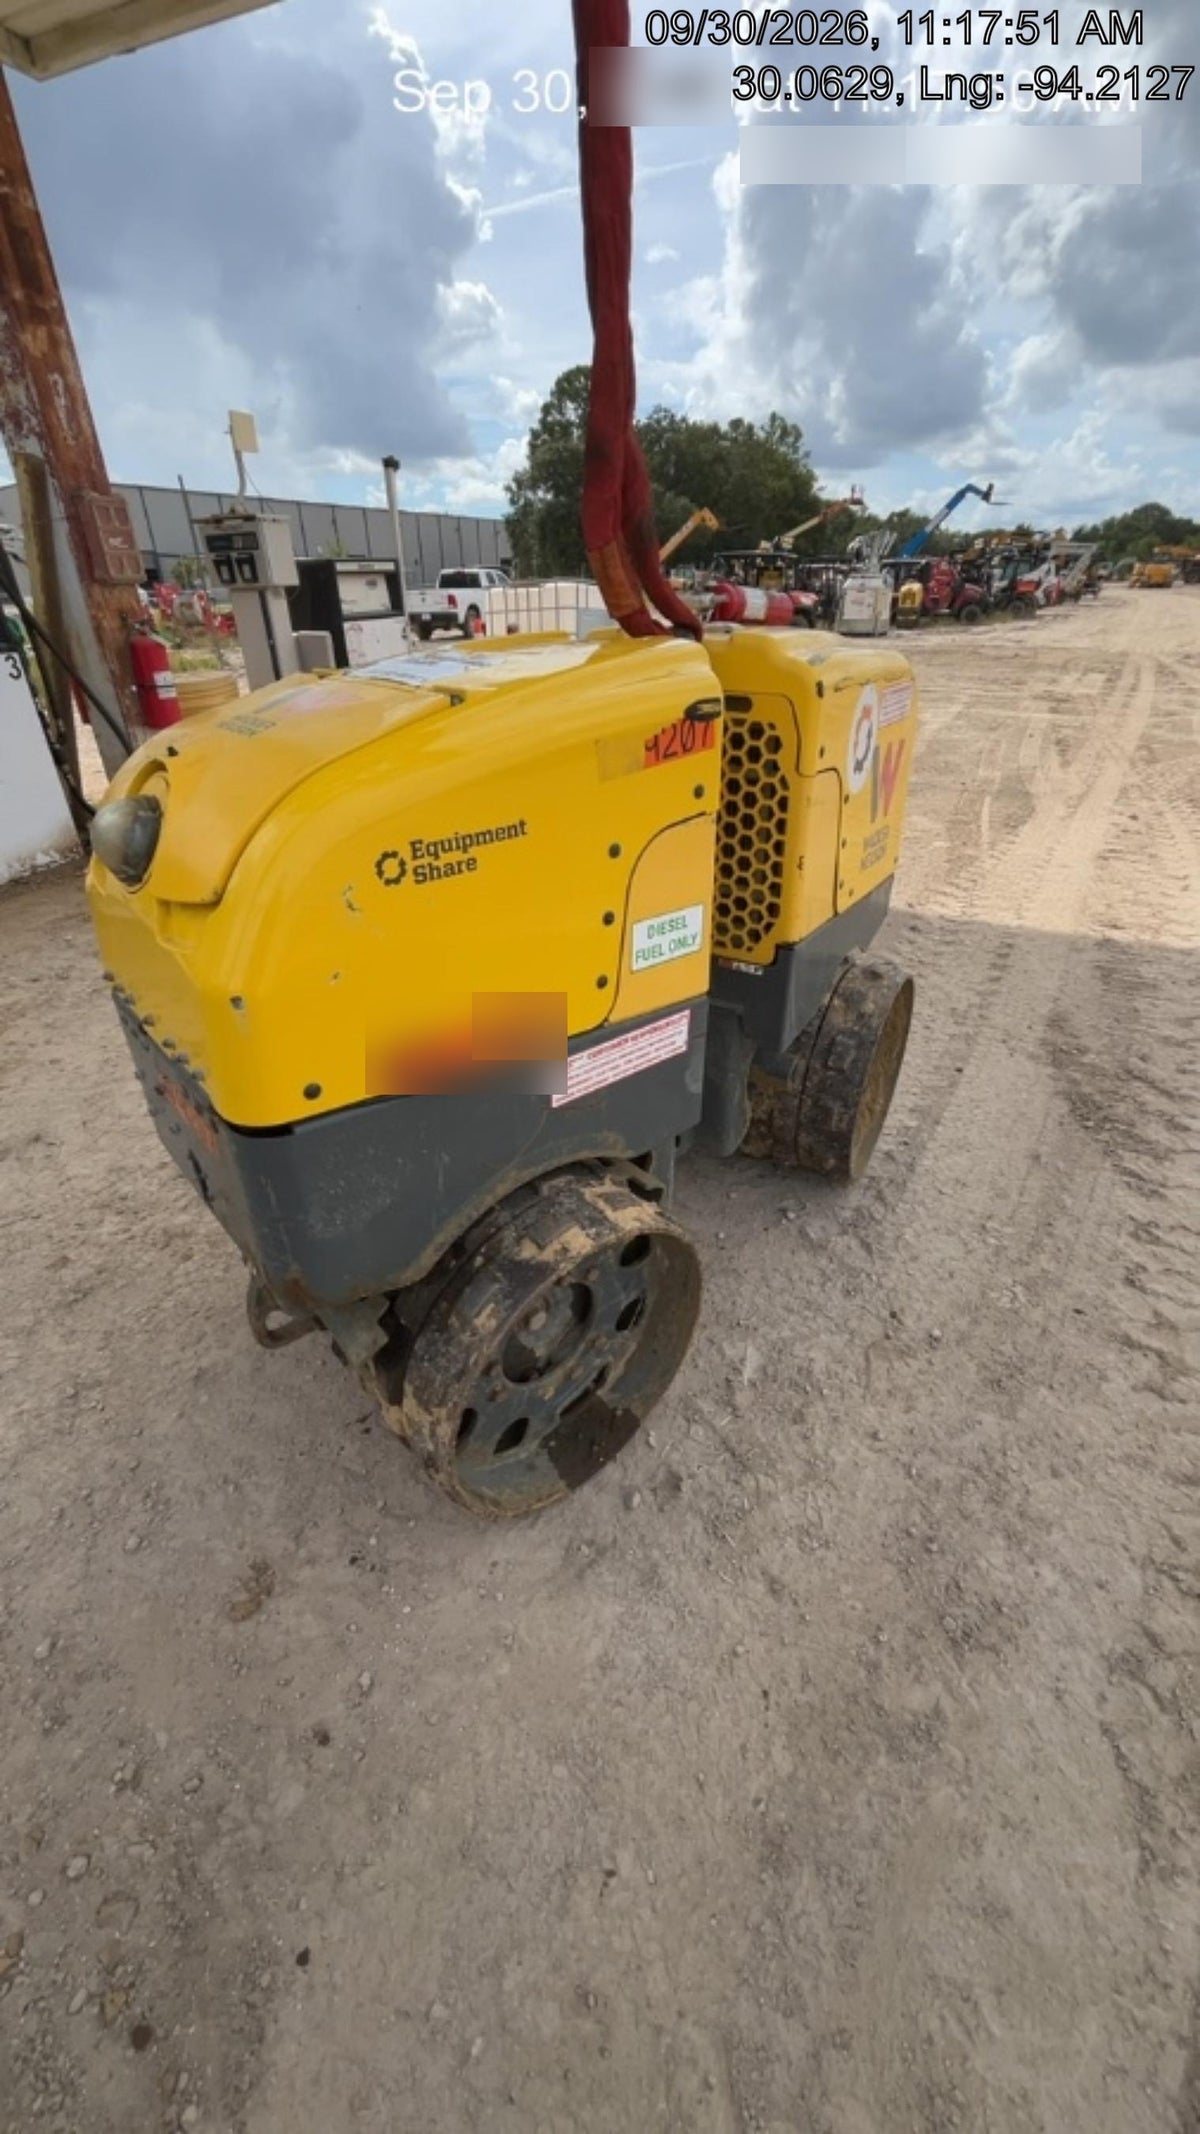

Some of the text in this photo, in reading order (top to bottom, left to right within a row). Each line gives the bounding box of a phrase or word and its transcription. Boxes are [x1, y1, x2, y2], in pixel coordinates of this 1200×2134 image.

[4, 654, 22, 680] 3
[409, 818, 528, 860] Equipment
[412, 855, 478, 886] Share
[646, 914, 688, 940] DIESEL
[635, 931, 699, 964] FUEL ONLY
